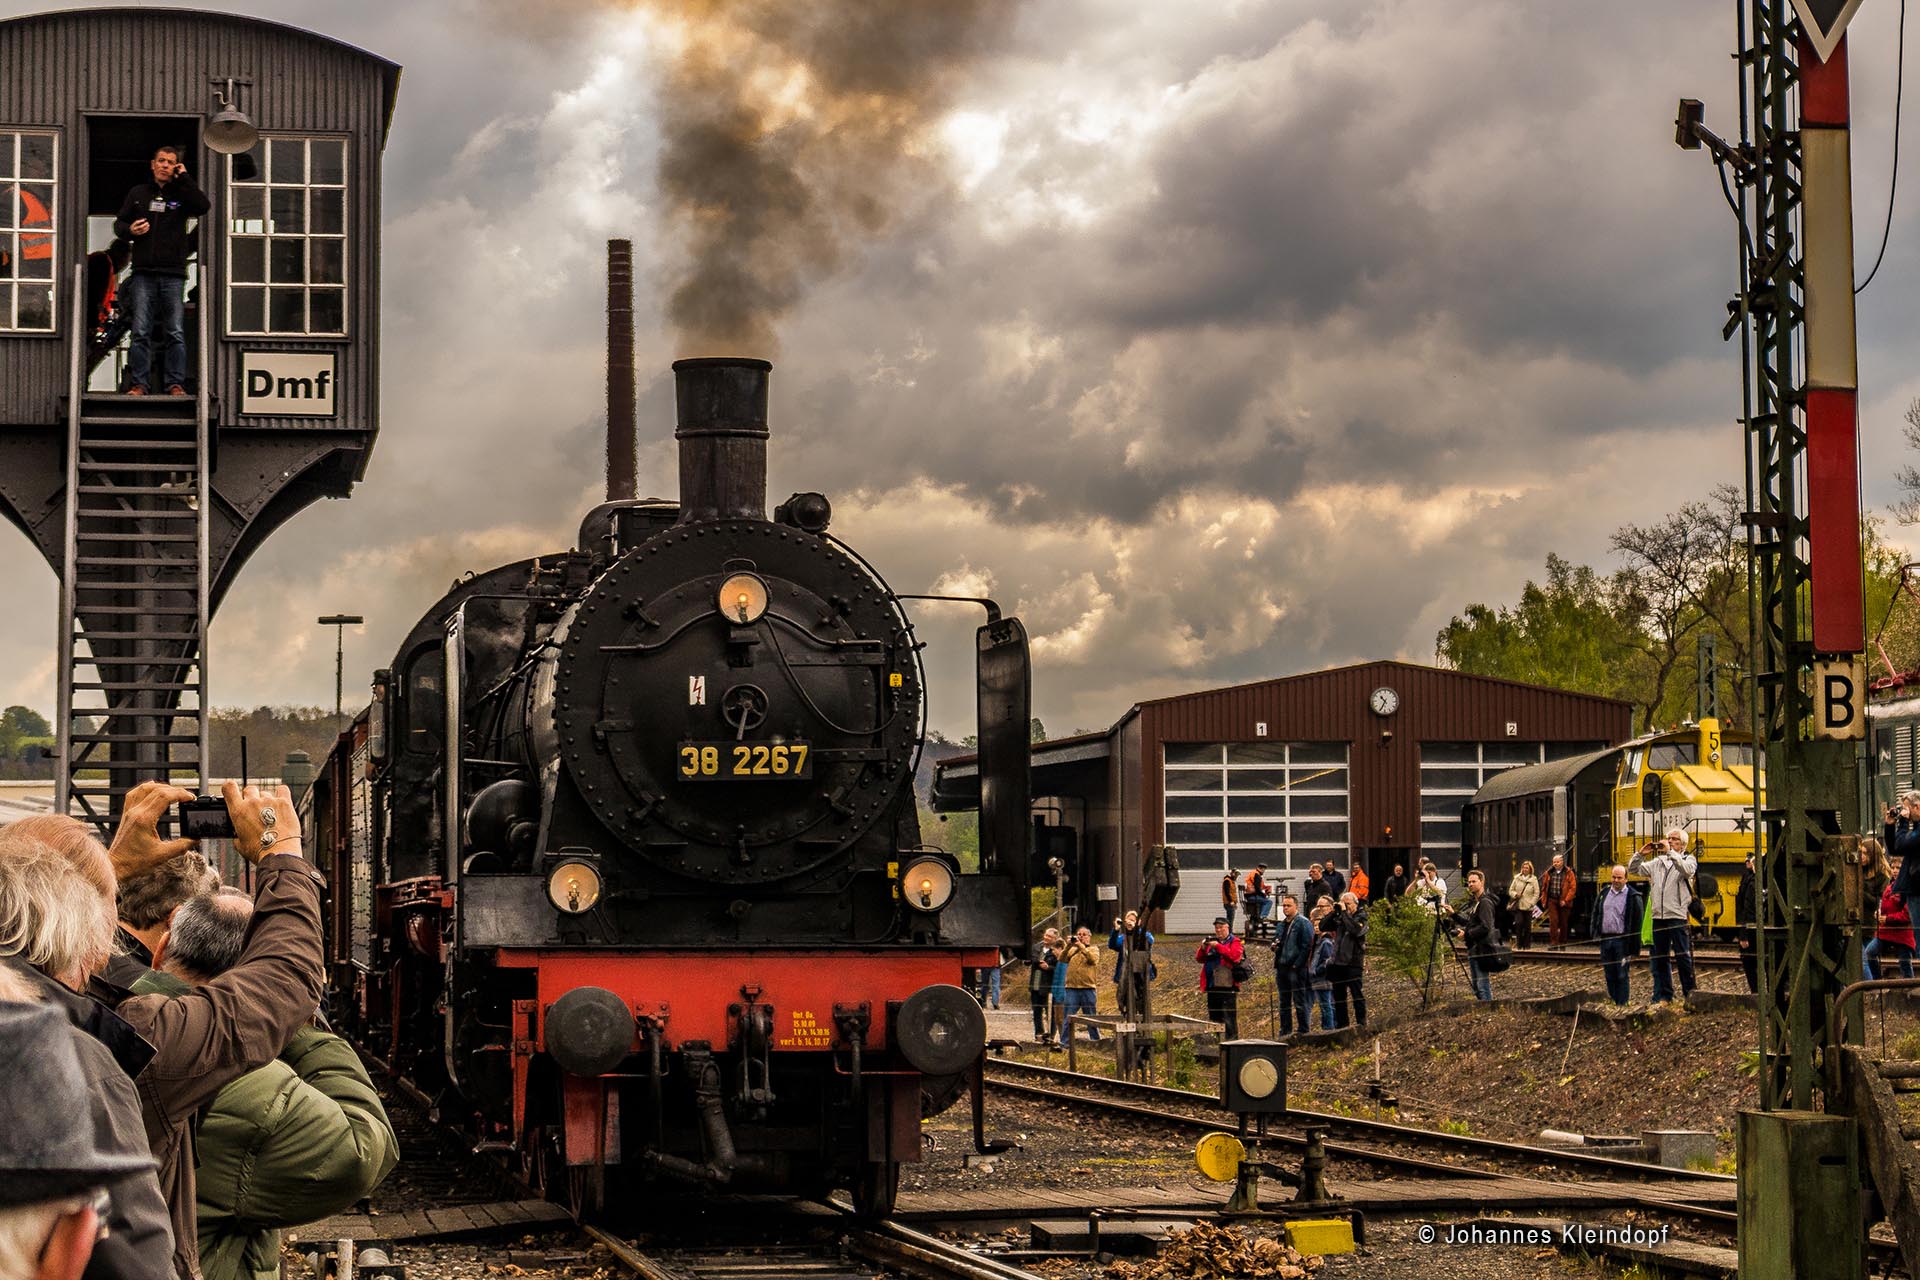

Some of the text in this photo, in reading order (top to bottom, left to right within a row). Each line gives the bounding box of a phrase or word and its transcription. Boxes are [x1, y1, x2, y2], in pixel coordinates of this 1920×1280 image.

[248, 370, 330, 399] Dmf
[1825, 675, 1854, 728] B
[1509, 725, 1516, 734] 2
[1709, 732, 1719, 750] 5
[681, 746, 808, 775] 38 2267
